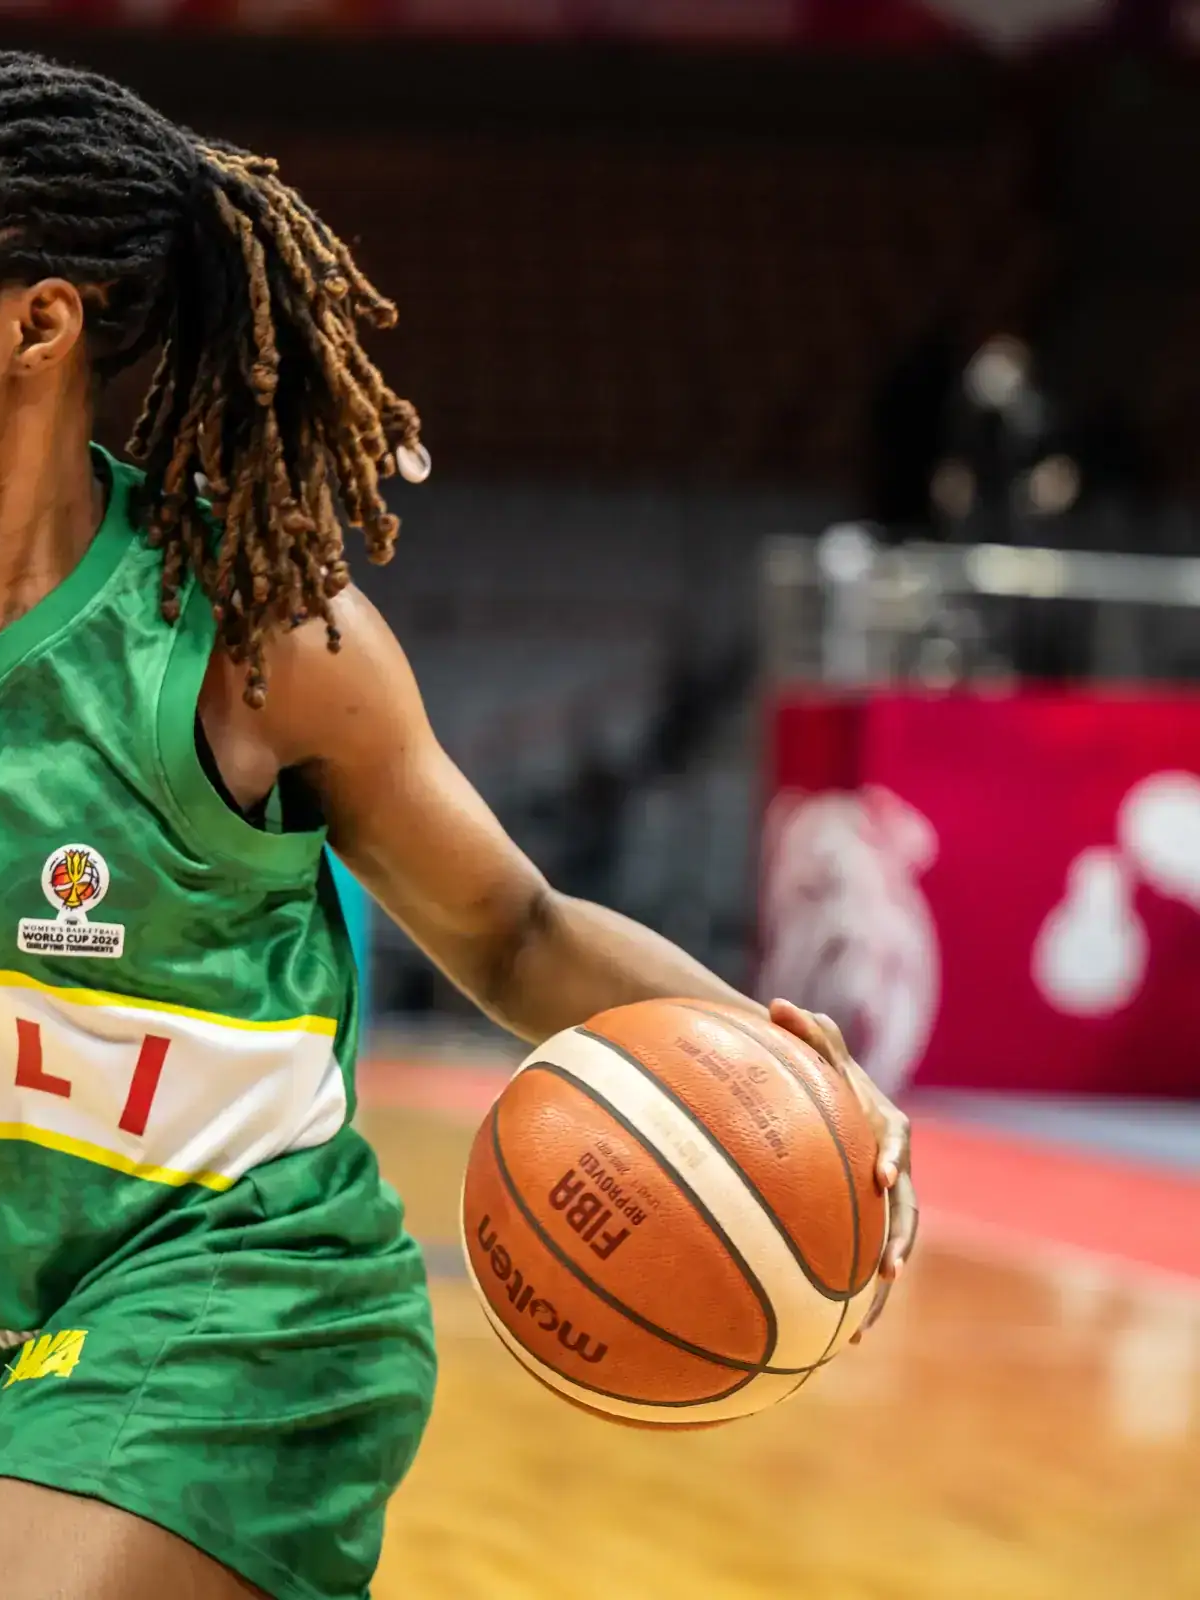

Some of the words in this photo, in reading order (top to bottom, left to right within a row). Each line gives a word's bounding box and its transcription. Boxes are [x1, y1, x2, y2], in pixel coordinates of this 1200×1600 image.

[22, 931, 64, 943] WORLD
[66, 934, 89, 944] CUP
[91, 935, 119, 946] 2026
[548, 1168, 632, 1261] FIBA
[579, 1152, 648, 1226] APPROVED
[478, 1213, 609, 1364] molten
